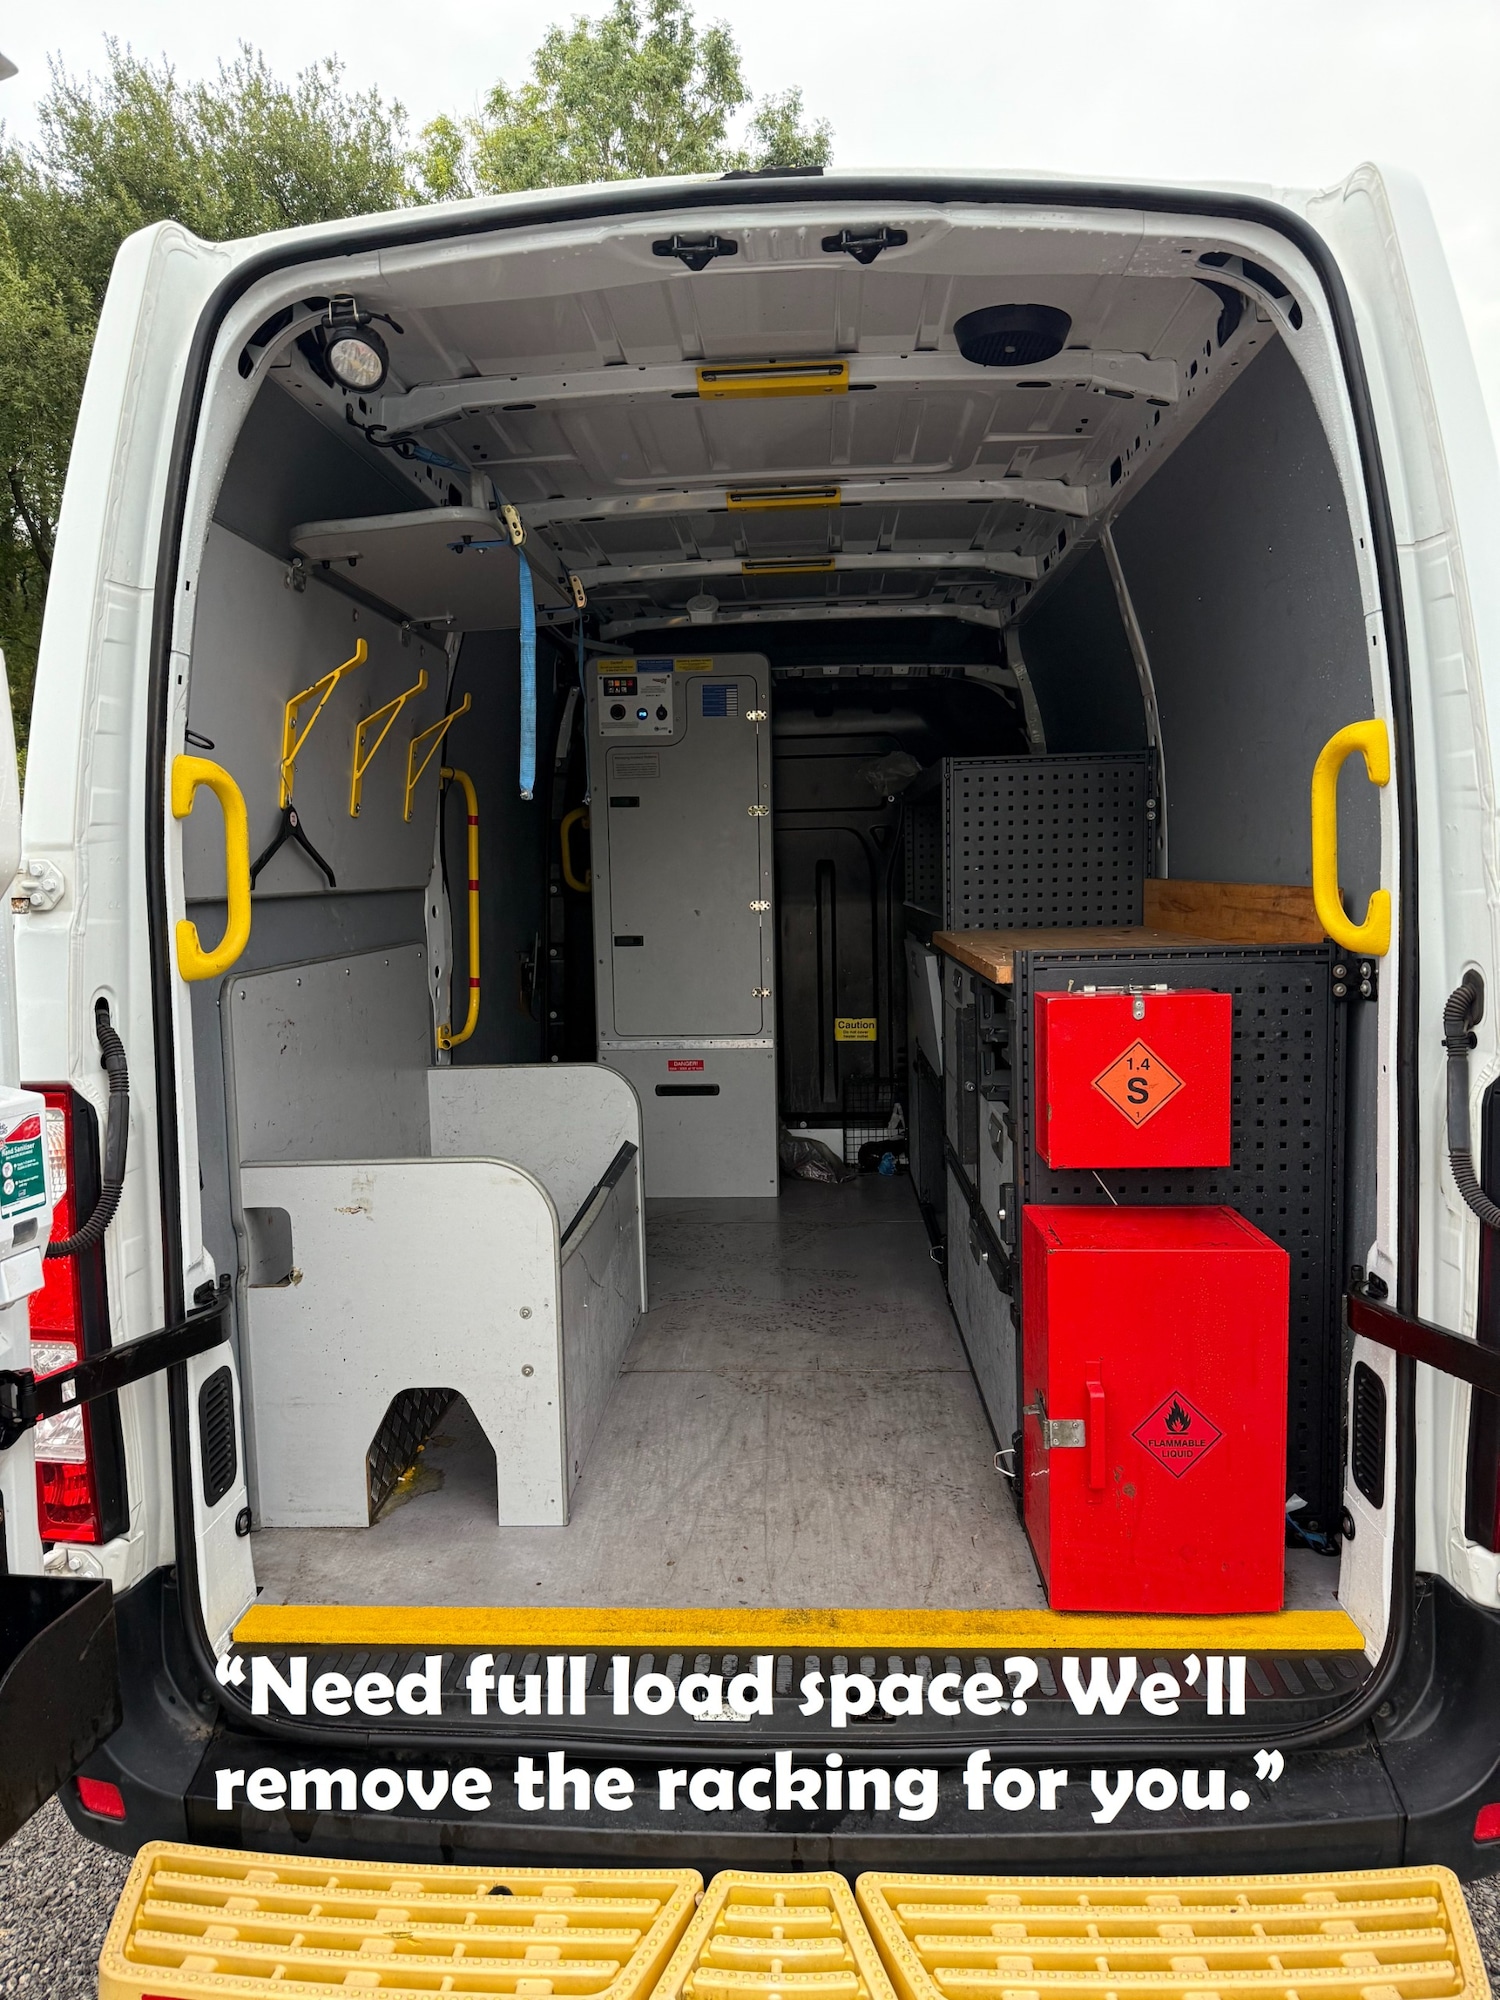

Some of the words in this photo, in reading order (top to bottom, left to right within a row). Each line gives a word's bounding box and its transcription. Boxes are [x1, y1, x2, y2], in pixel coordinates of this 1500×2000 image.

[838, 1021, 875, 1029] Caution
[1126, 1058, 1150, 1070] 1.4
[1127, 1077, 1149, 1104] S
[1, 1145, 14, 1157] Hand
[14, 1142, 35, 1154] Sanitiser
[1162, 1450, 1193, 1458] LIQUID
